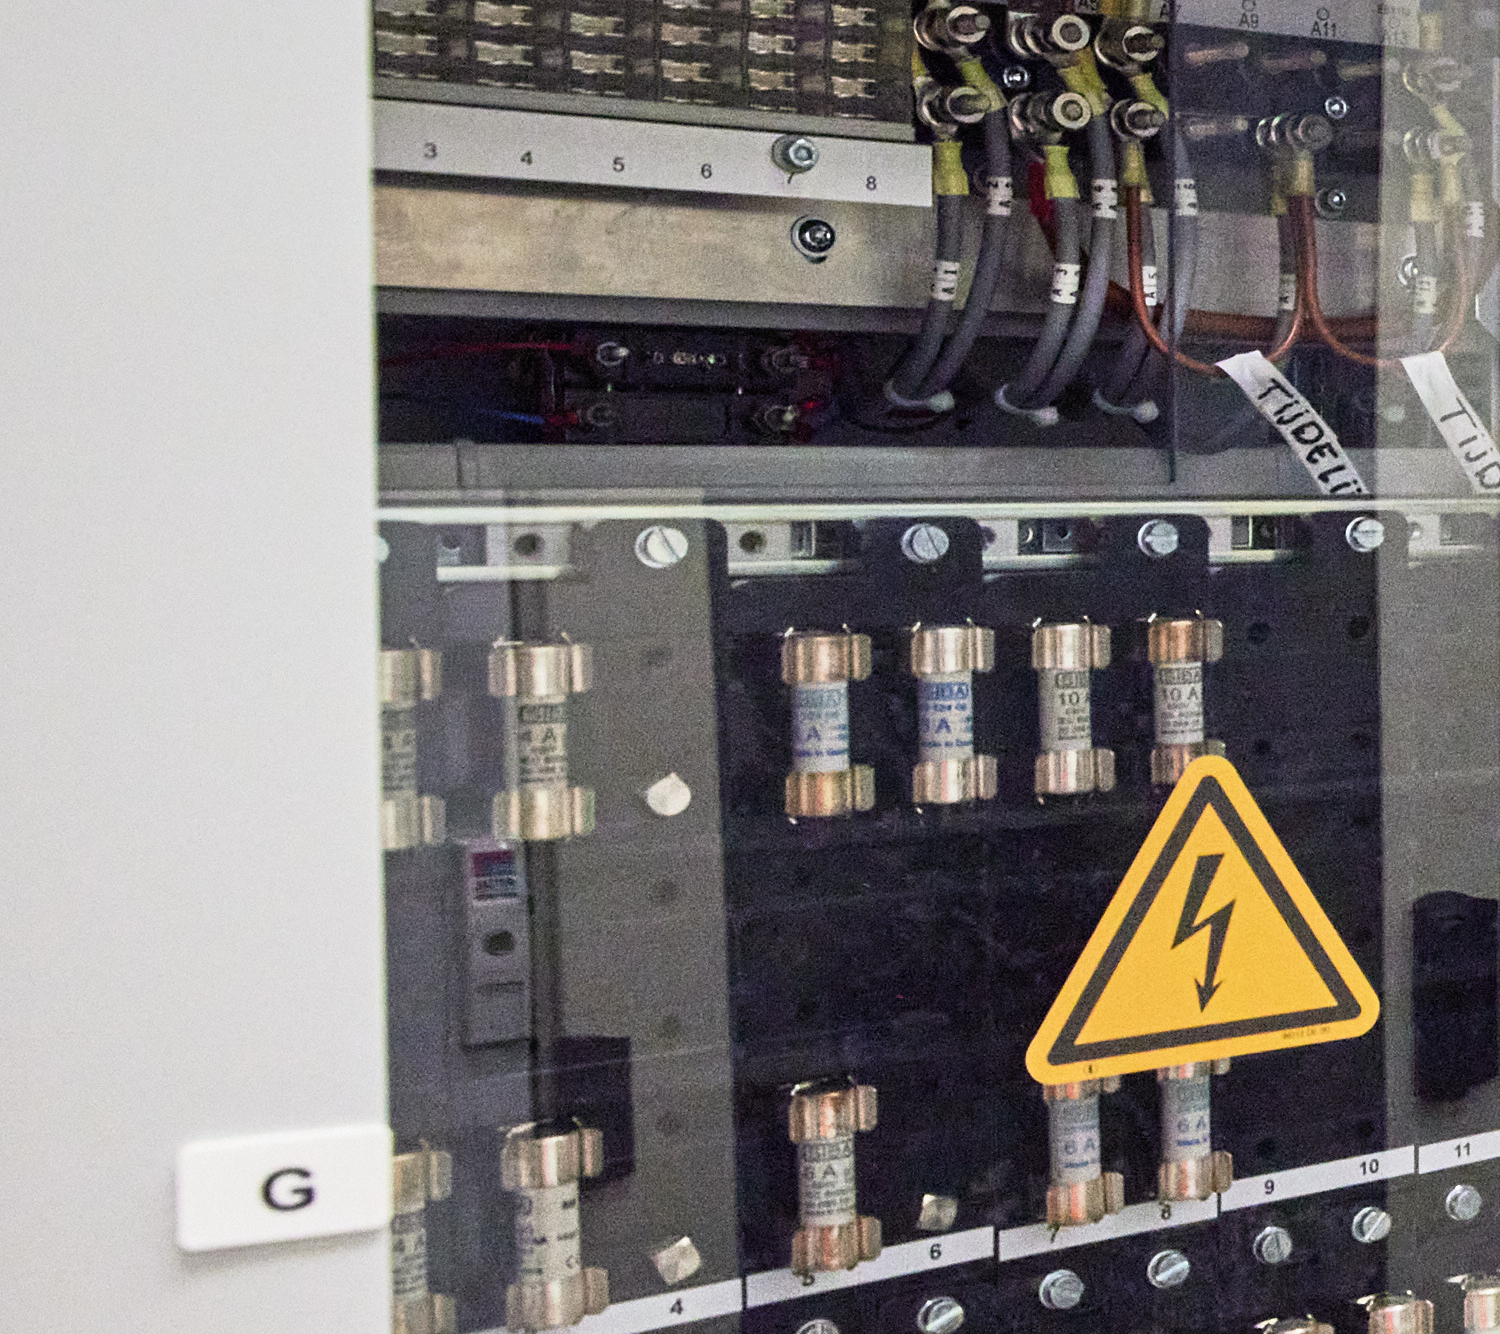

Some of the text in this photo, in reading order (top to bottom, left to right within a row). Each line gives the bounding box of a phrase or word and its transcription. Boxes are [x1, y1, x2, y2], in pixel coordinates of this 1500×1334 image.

[1239, 12, 1260, 29] A9
[1310, 20, 1337, 38] A11
[423, 143, 877, 192] 3 4 5 6 8
[1257, 377, 1363, 494] TIJDELI
[260, 1166, 316, 1212] G
[669, 1297, 684, 1316] 4
[929, 1243, 941, 1260] 6
[1264, 1179, 1275, 1195] 9
[1359, 1158, 1380, 1175] 10
[1454, 1142, 1471, 1158] 11
